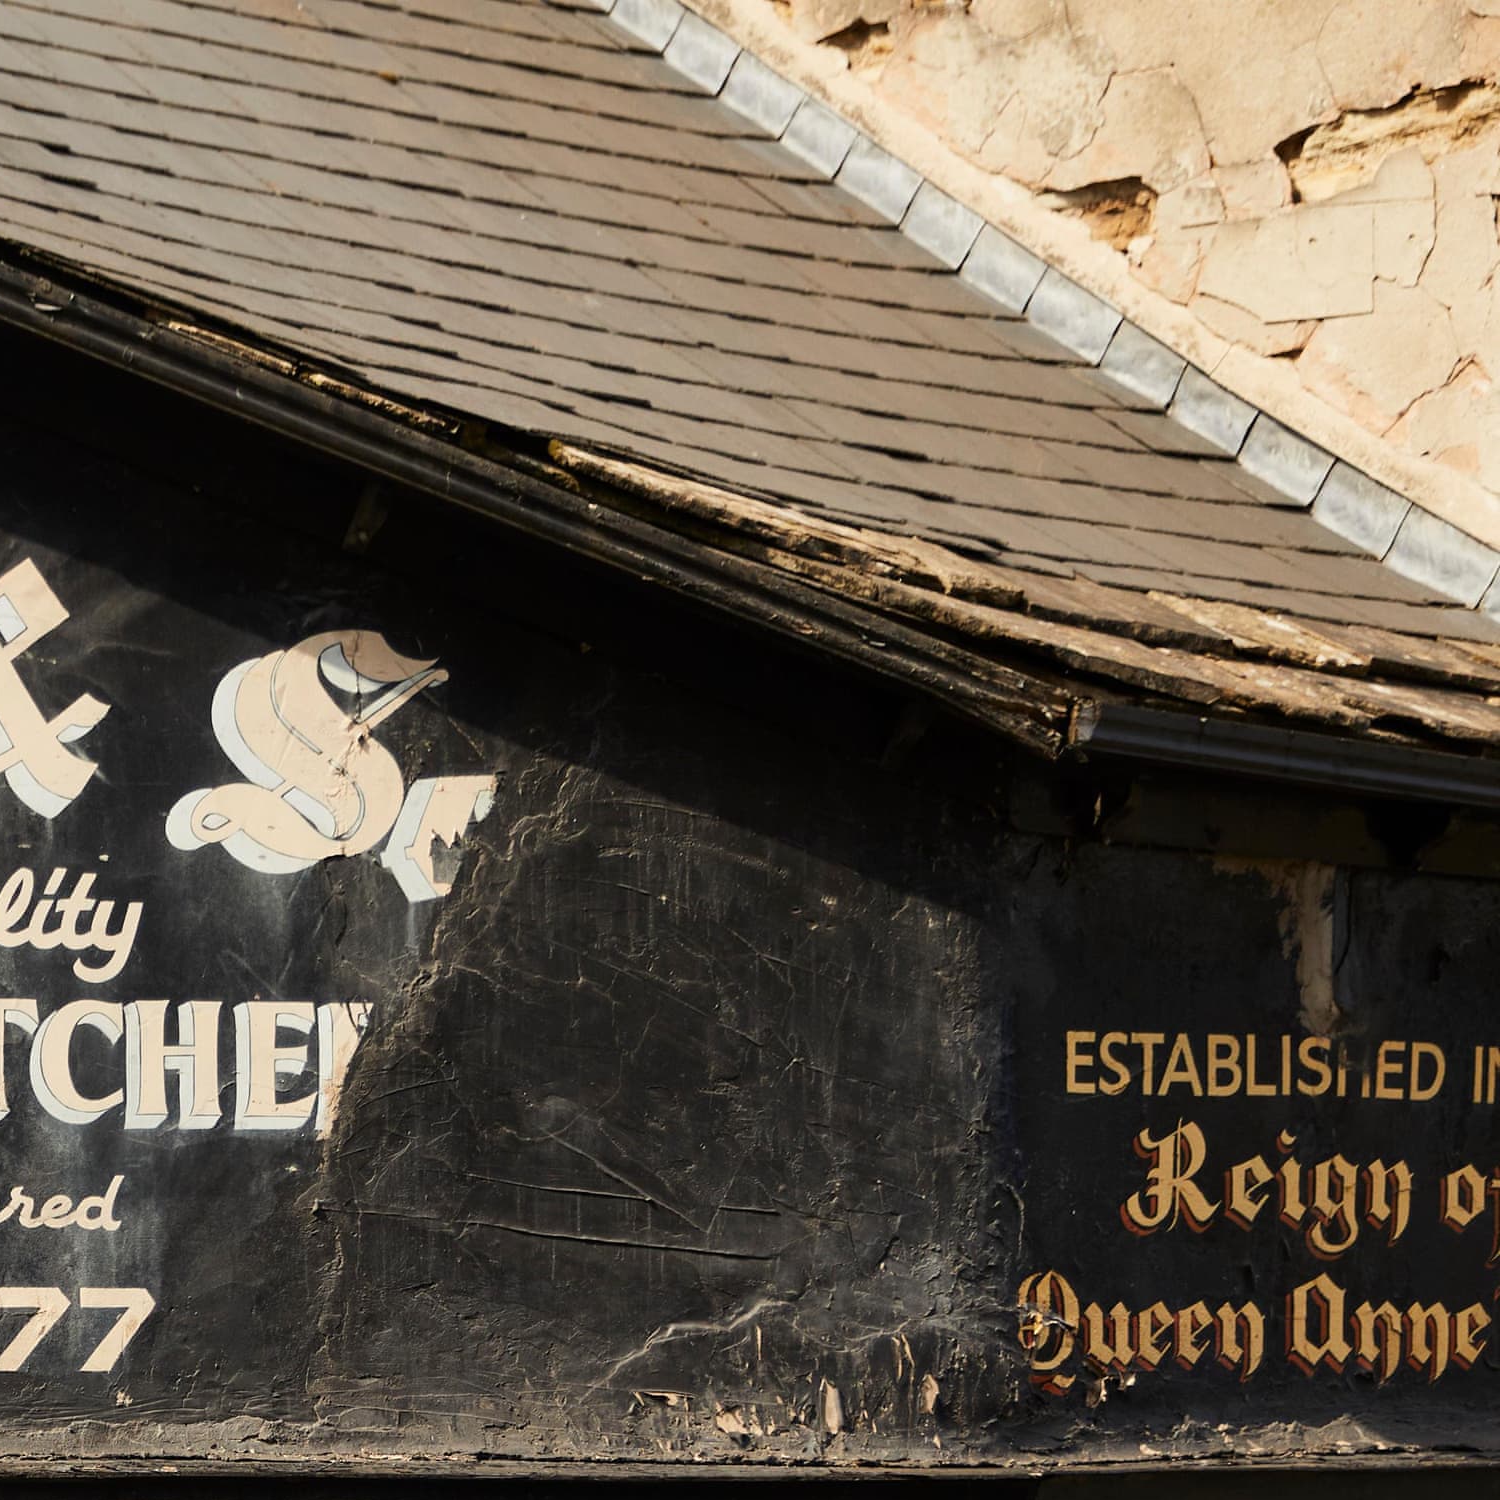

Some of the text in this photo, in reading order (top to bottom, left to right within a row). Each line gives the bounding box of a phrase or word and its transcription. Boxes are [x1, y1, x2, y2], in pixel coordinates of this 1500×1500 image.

[1120, 1117, 1414, 1260] Reign
[1016, 1270, 1500, 1392] Queen Anne
